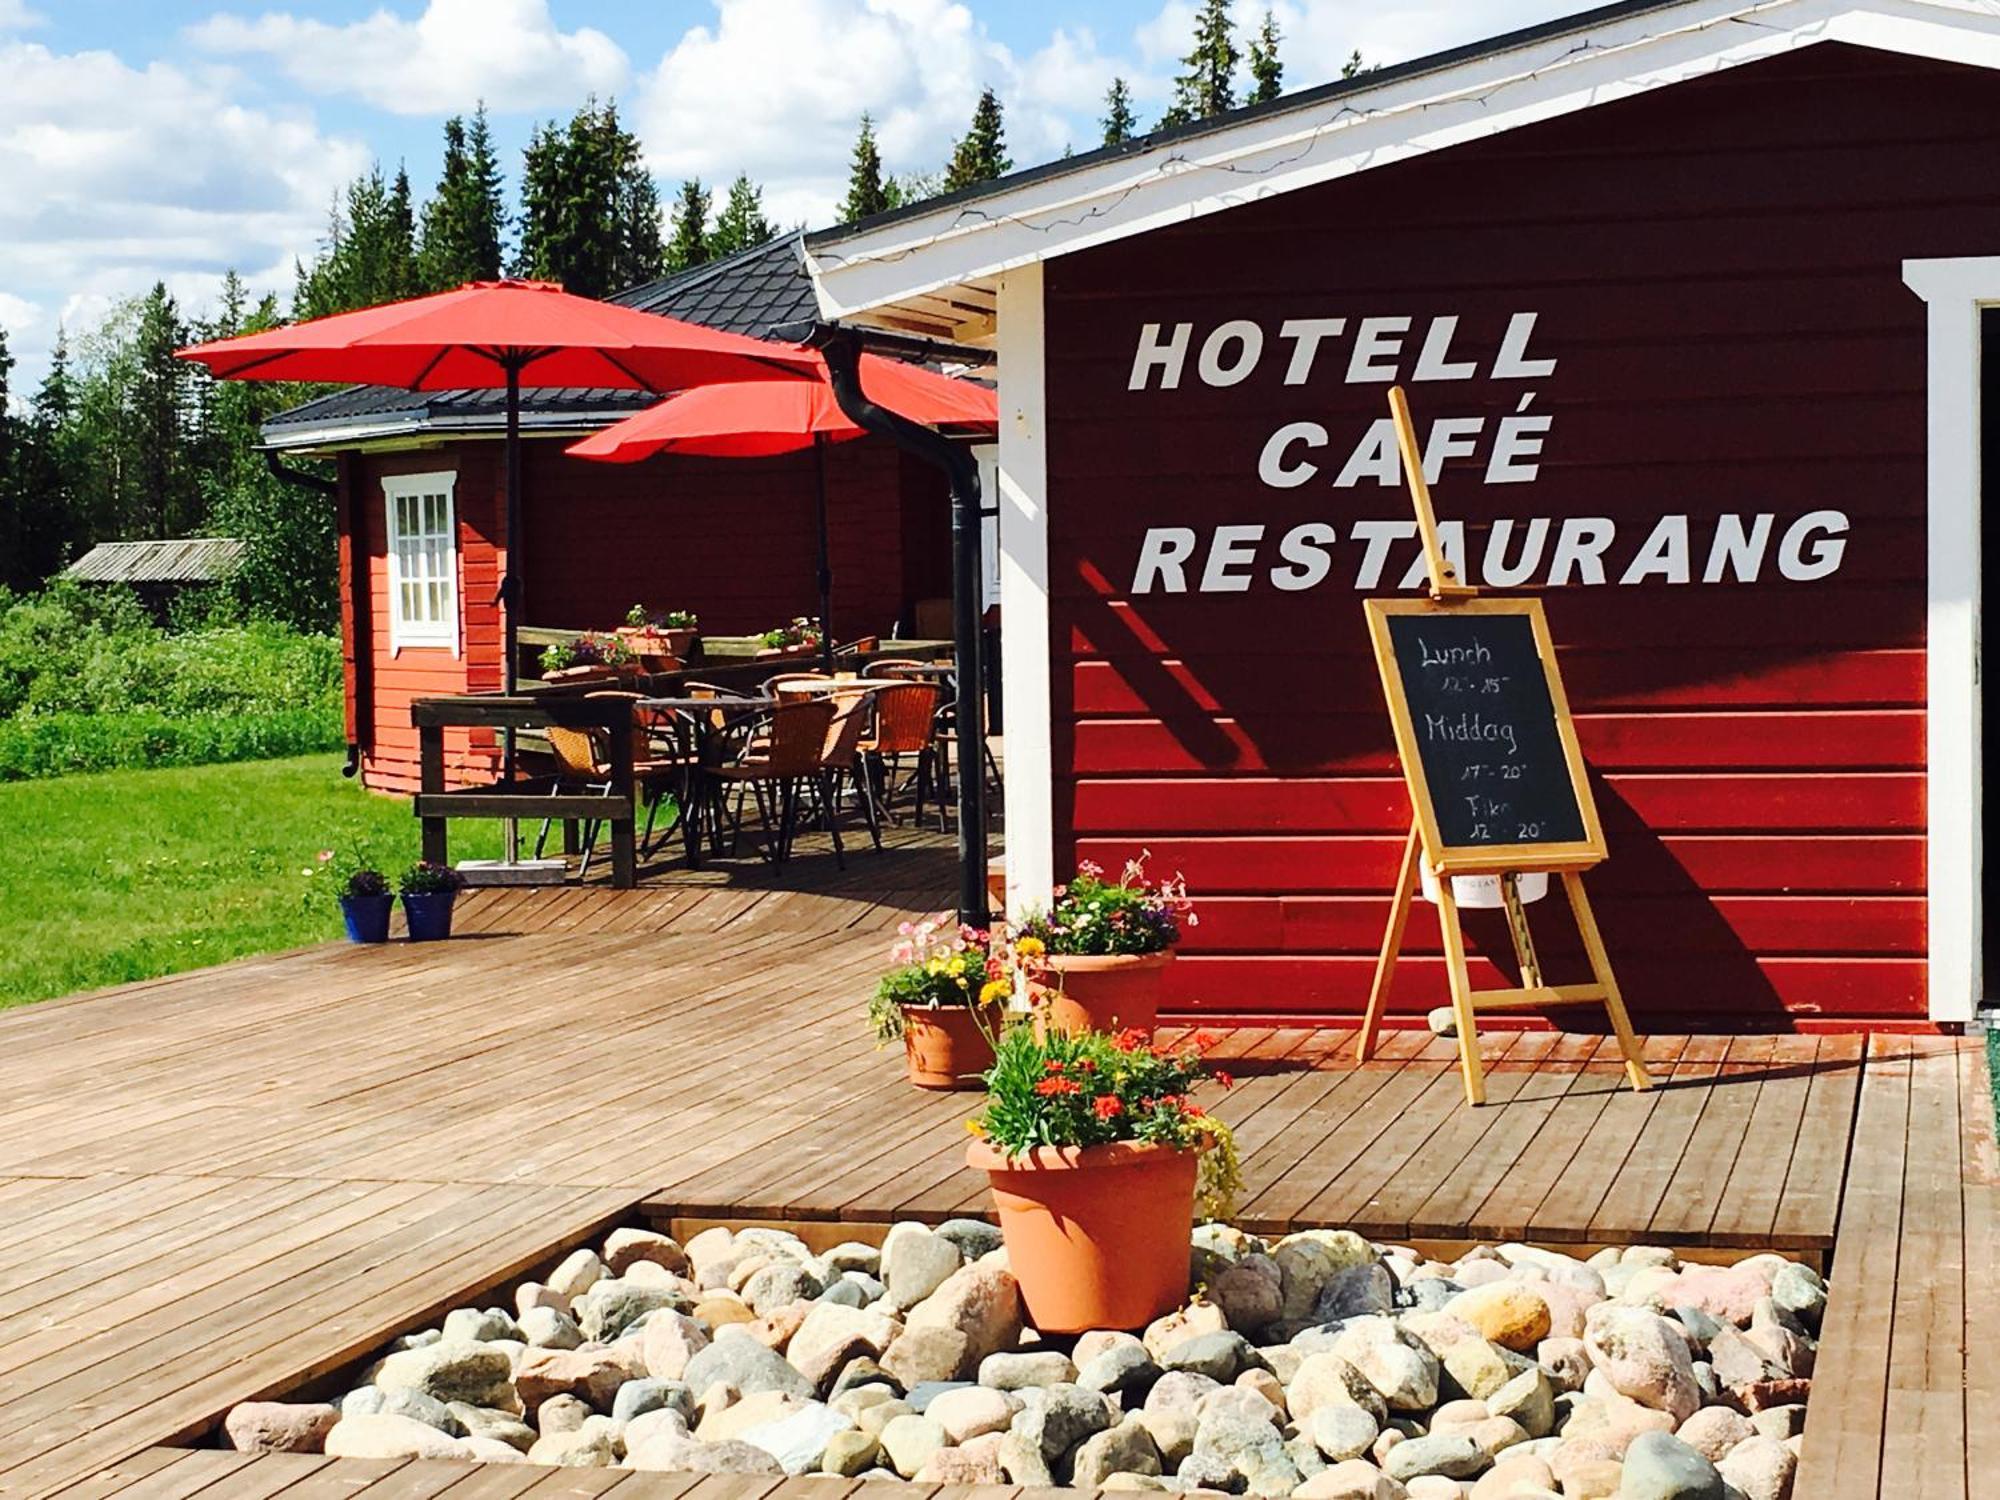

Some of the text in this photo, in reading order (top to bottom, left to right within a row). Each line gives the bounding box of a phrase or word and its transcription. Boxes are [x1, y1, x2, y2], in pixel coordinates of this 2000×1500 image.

[1127, 311, 1558, 391] HOTELL
[1257, 392, 1553, 488] CAFÉ
[1130, 509, 1850, 594] RESTAURANG
[1417, 635, 1492, 668] Lunch
[1425, 712, 1518, 755] Middag
